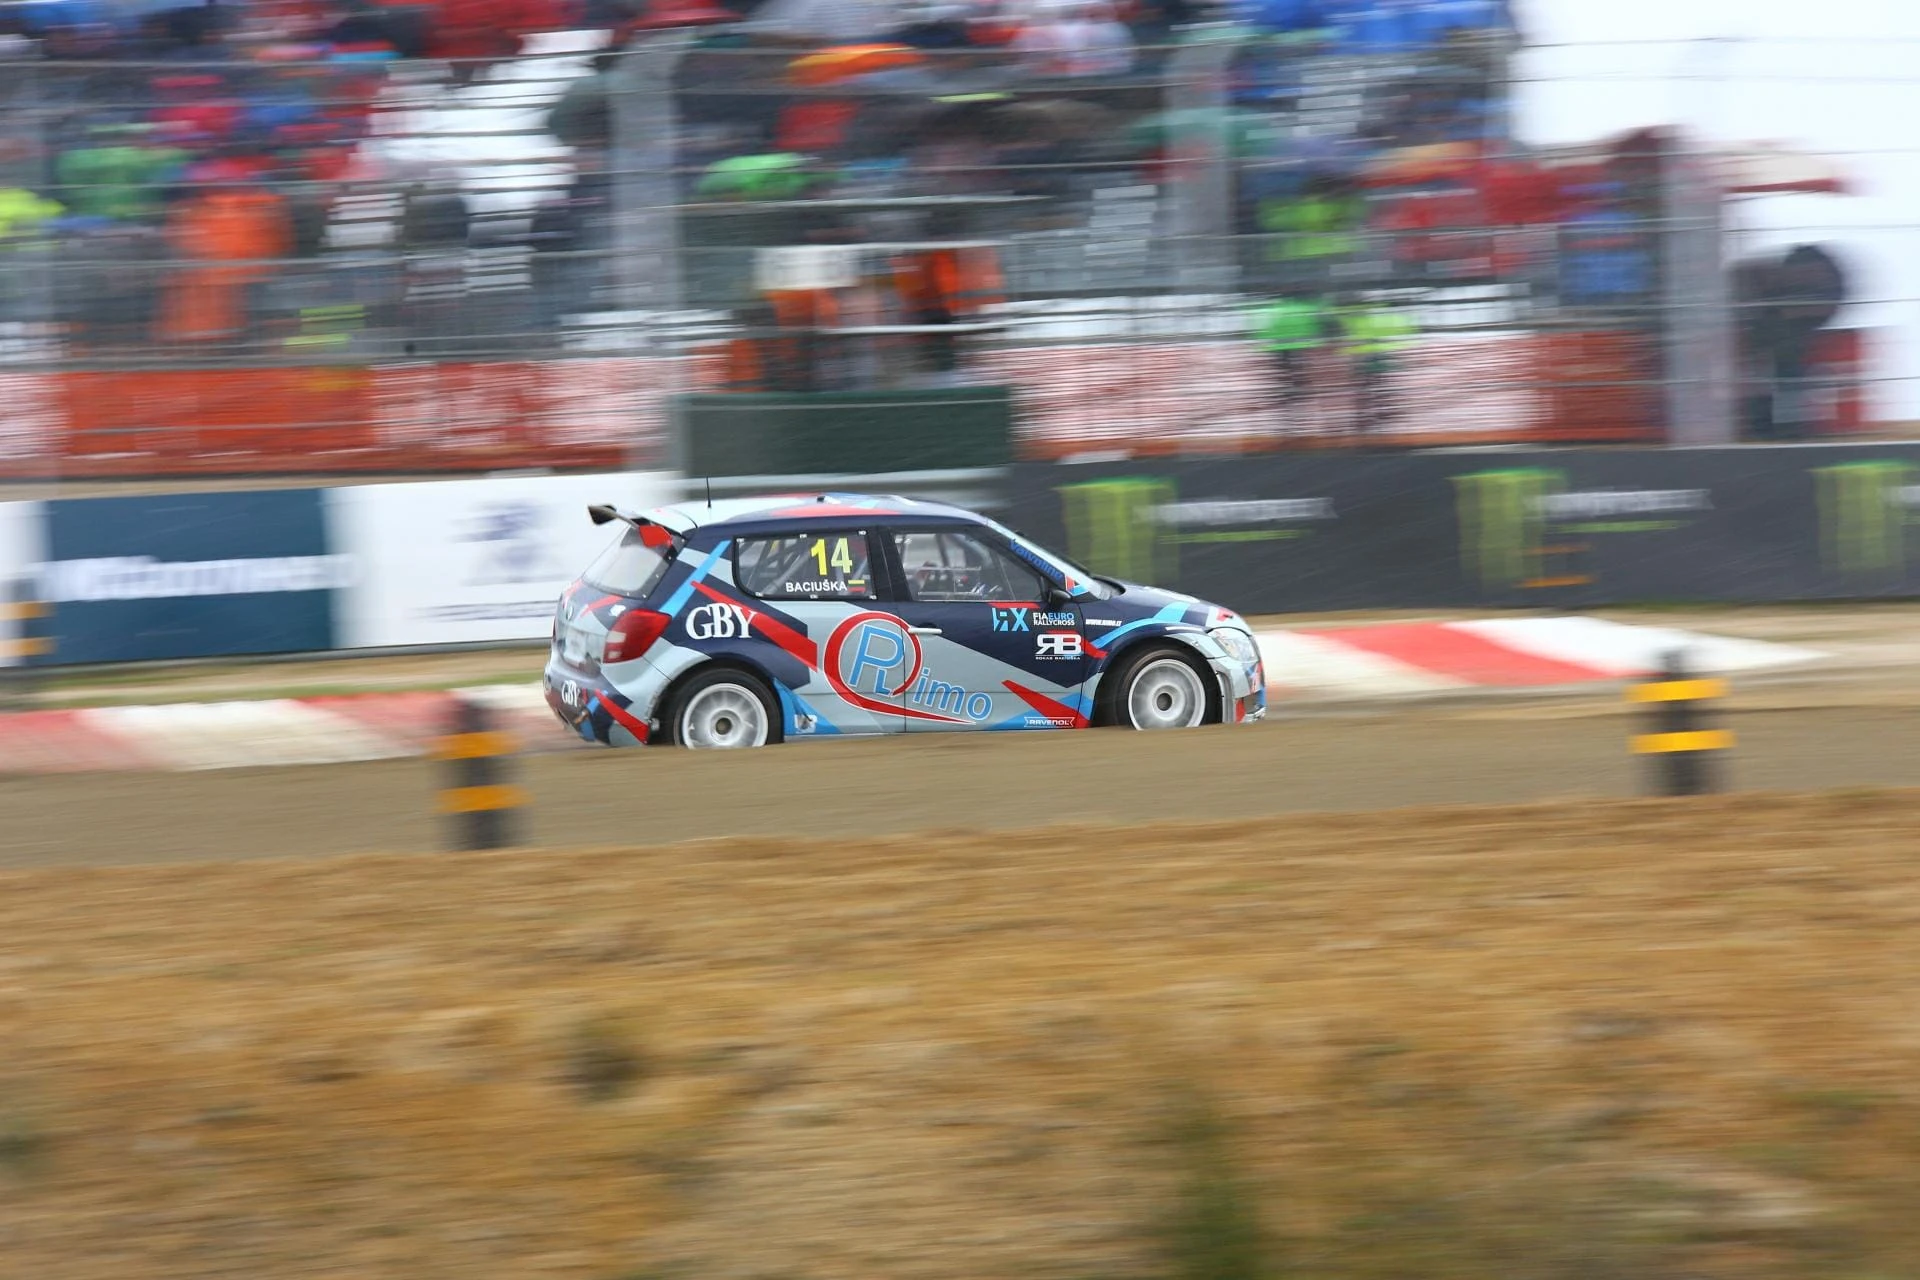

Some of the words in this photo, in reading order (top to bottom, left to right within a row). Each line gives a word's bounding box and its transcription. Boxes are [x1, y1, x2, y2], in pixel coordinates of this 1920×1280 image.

[811, 537, 853, 576] 14
[785, 578, 848, 593] BACIUŠKA
[685, 602, 758, 640] GBY
